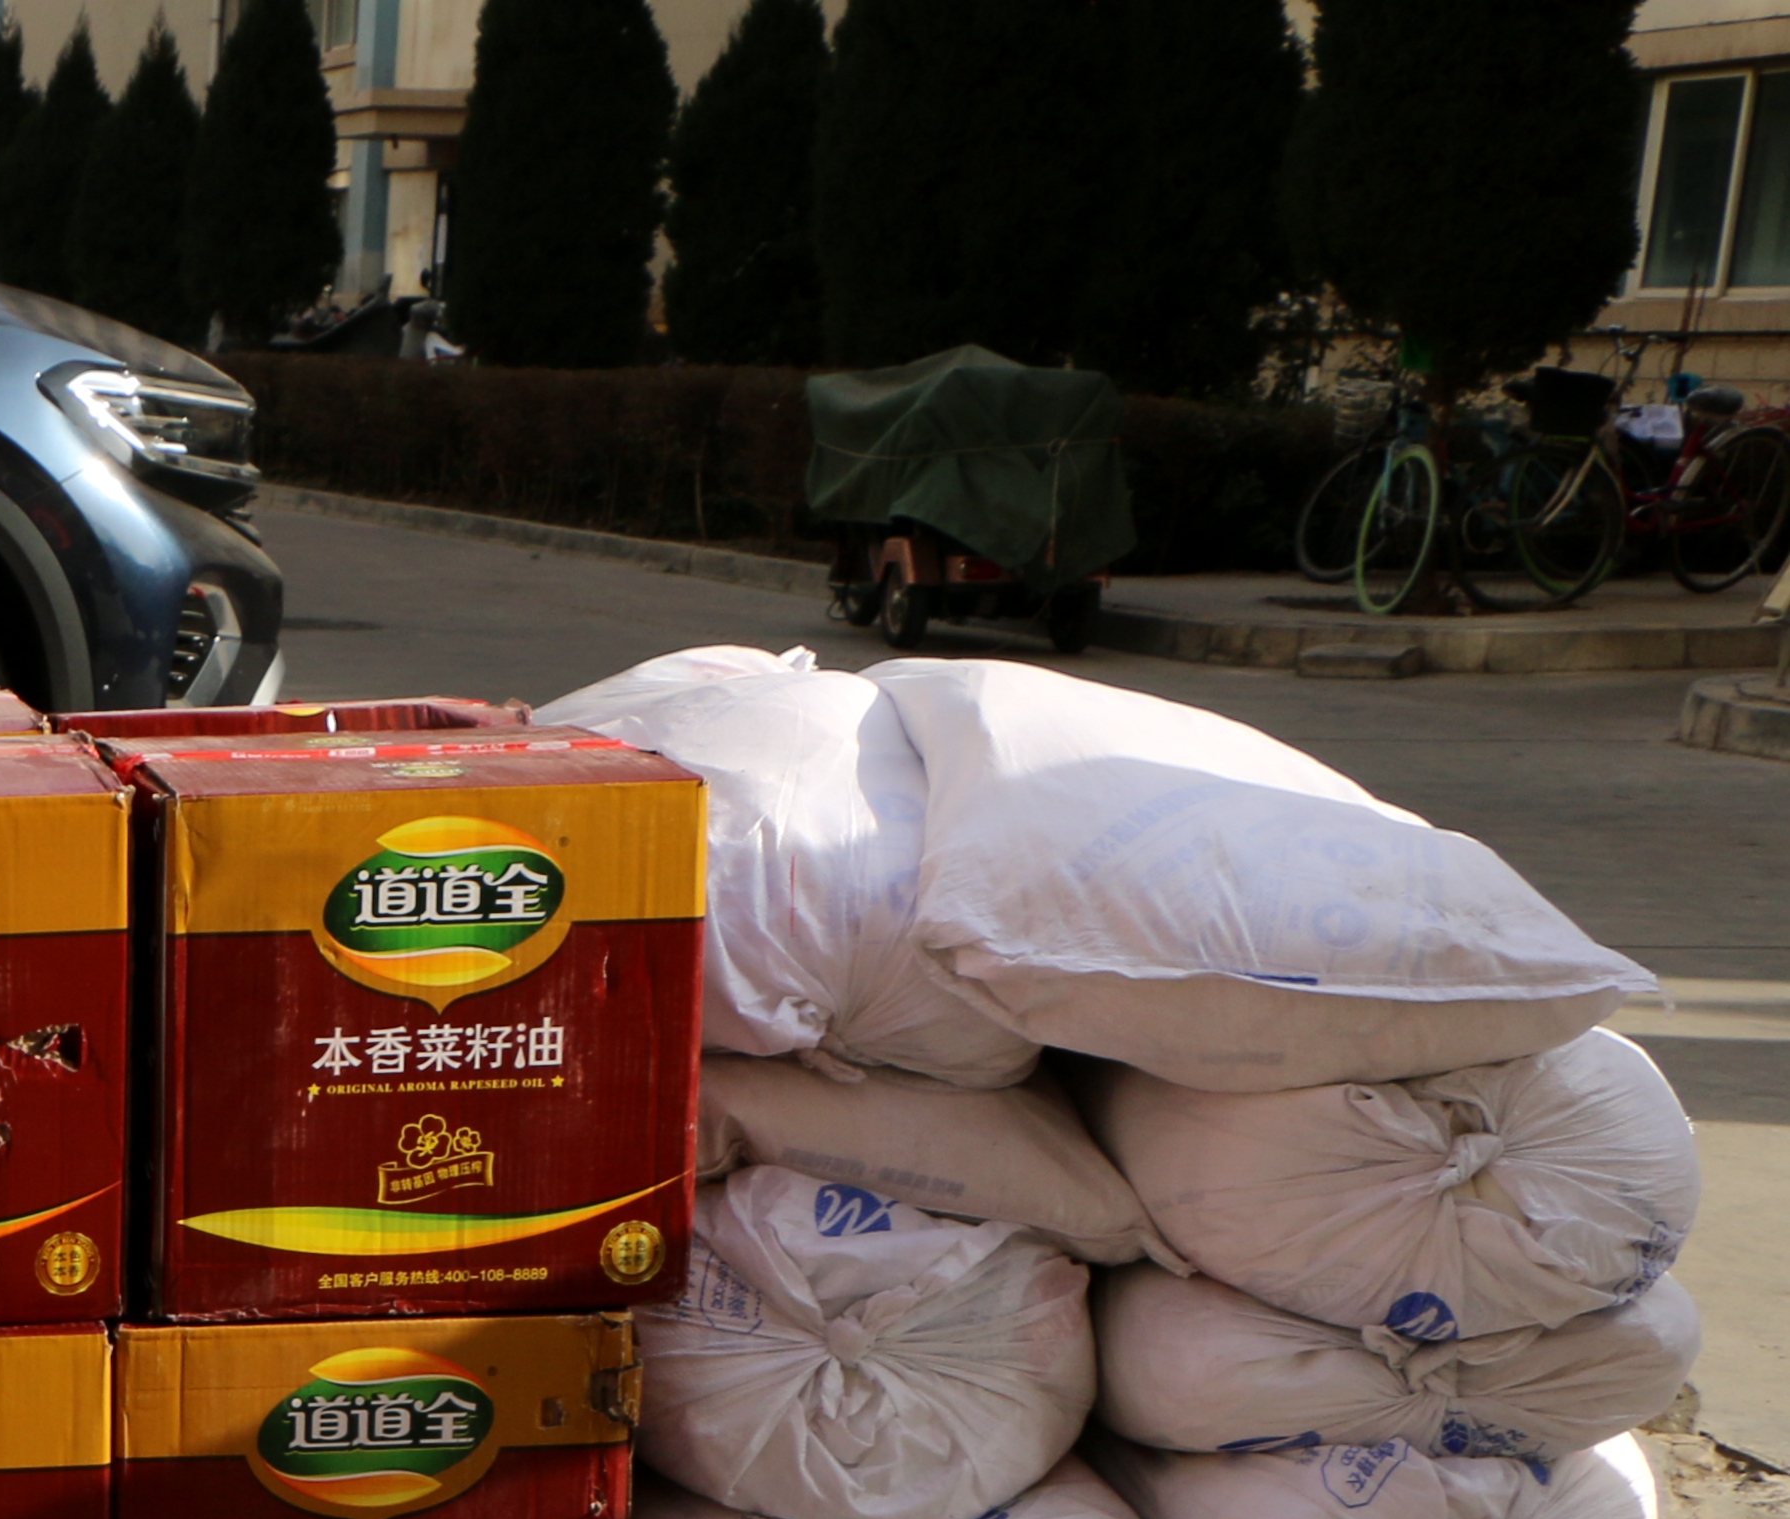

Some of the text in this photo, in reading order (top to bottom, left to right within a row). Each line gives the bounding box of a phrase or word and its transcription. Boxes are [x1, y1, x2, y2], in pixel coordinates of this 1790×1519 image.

[353, 863, 549, 925] 道道全
[312, 1016, 565, 1077] 本香菜籽油
[327, 1077, 546, 1095] ORIGINAL AROMA RAPESEED OIL
[286, 1392, 478, 1449] 道道全
